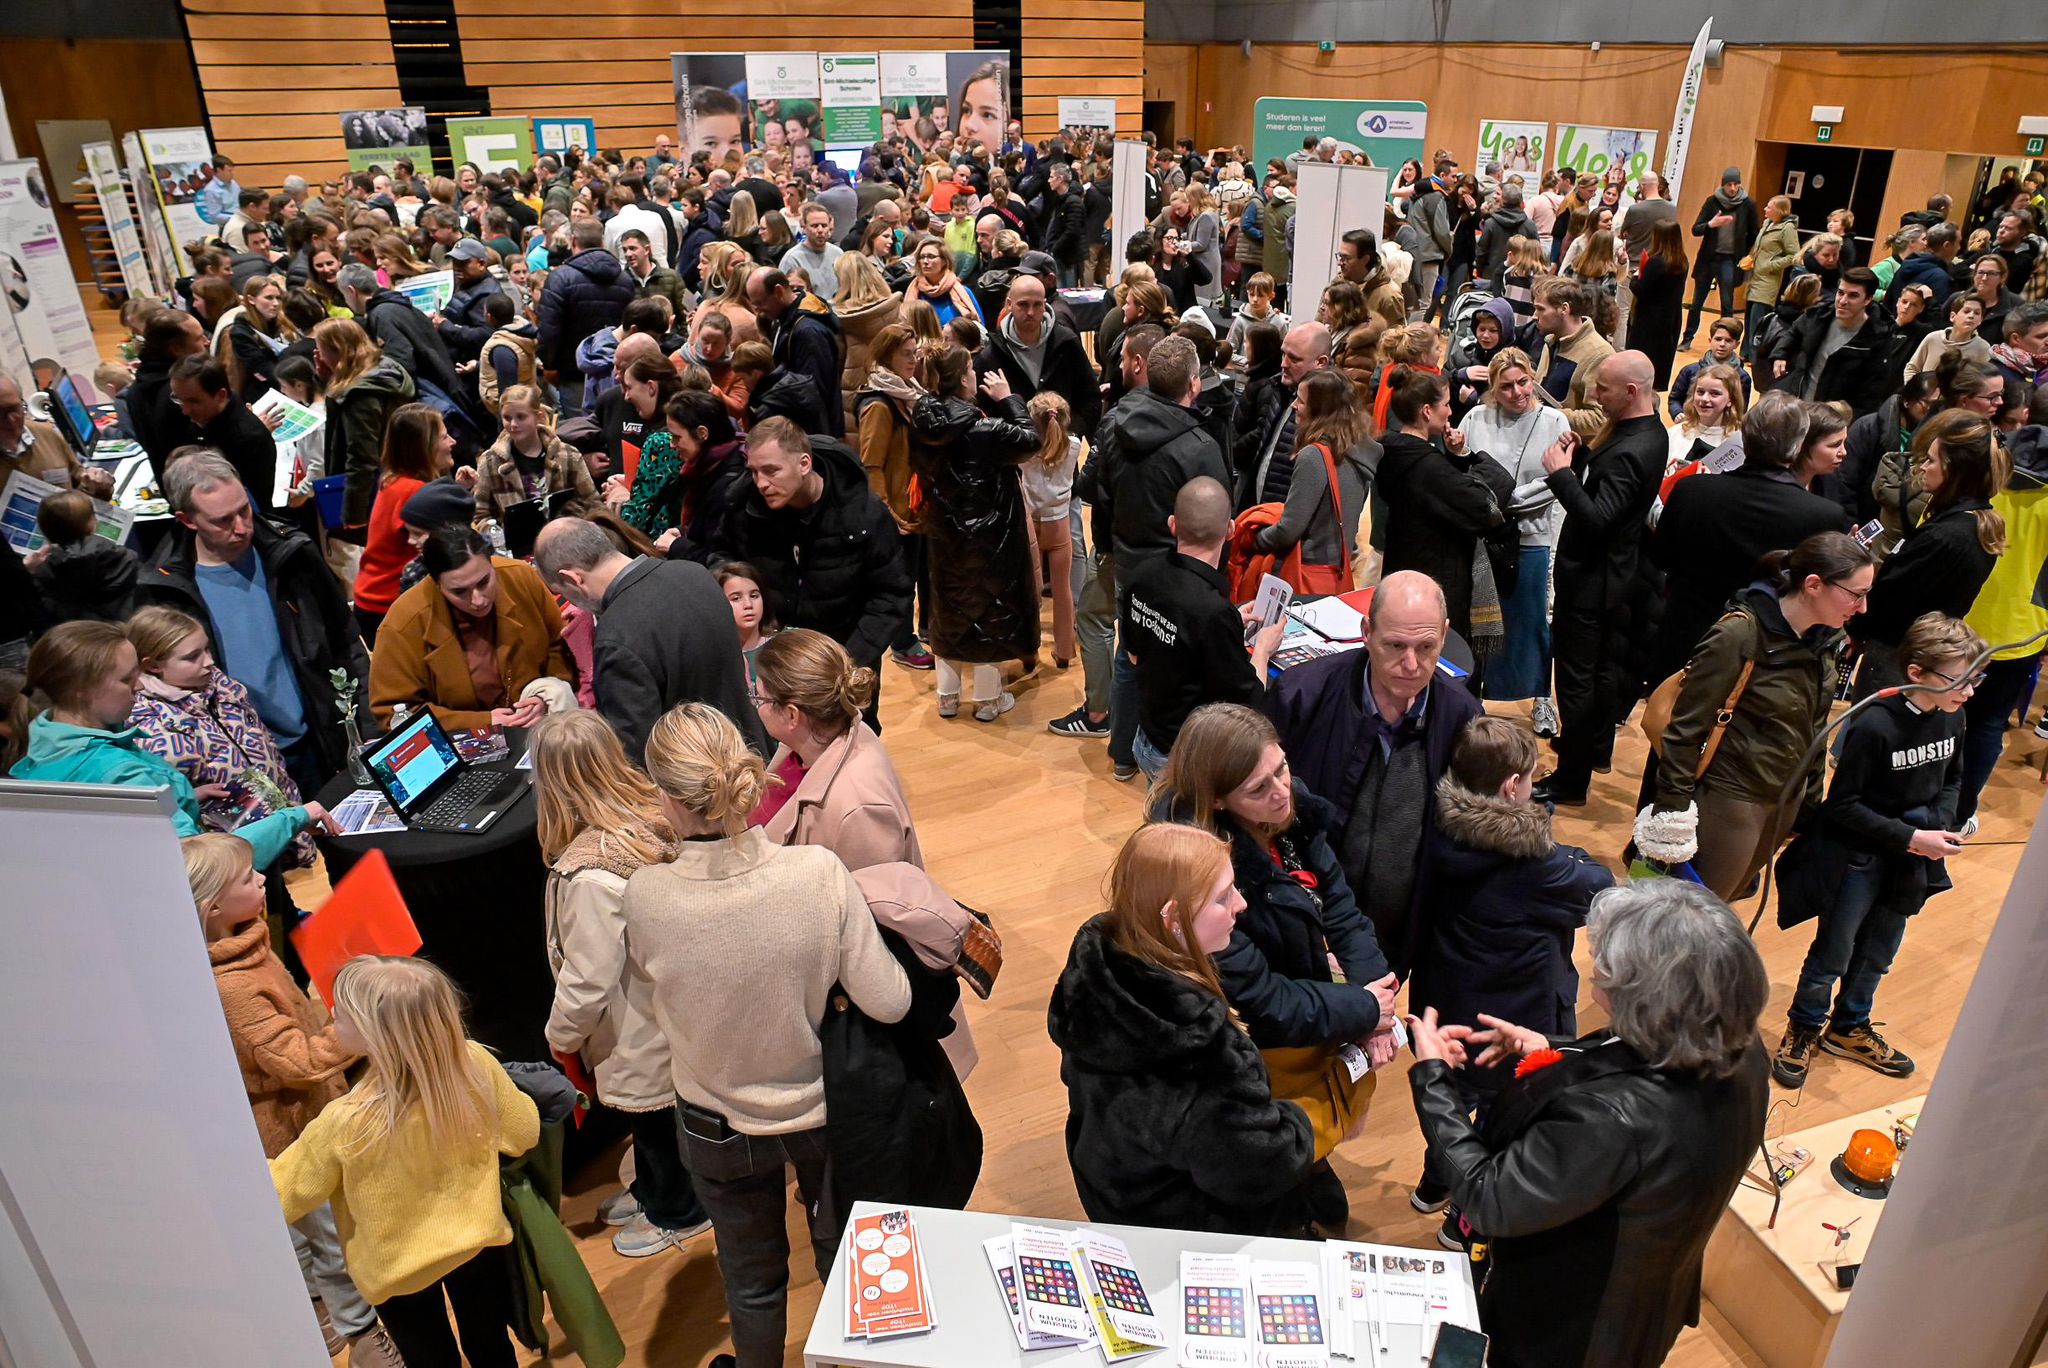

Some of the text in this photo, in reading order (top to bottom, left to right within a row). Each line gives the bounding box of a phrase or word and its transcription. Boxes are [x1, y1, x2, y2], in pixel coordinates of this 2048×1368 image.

[1265, 112, 1301, 121] Studeren
[1287, 123, 1301, 131] dan
[1303, 124, 1325, 132] leren!
[622, 421, 643, 433] VANS
[1166, 621, 1178, 633] aan
[1039, 1314, 1077, 1324] SCHOTEN
[1039, 1319, 1078, 1330] ATHENEUM
[1122, 1323, 1154, 1333] SCHOTEN
